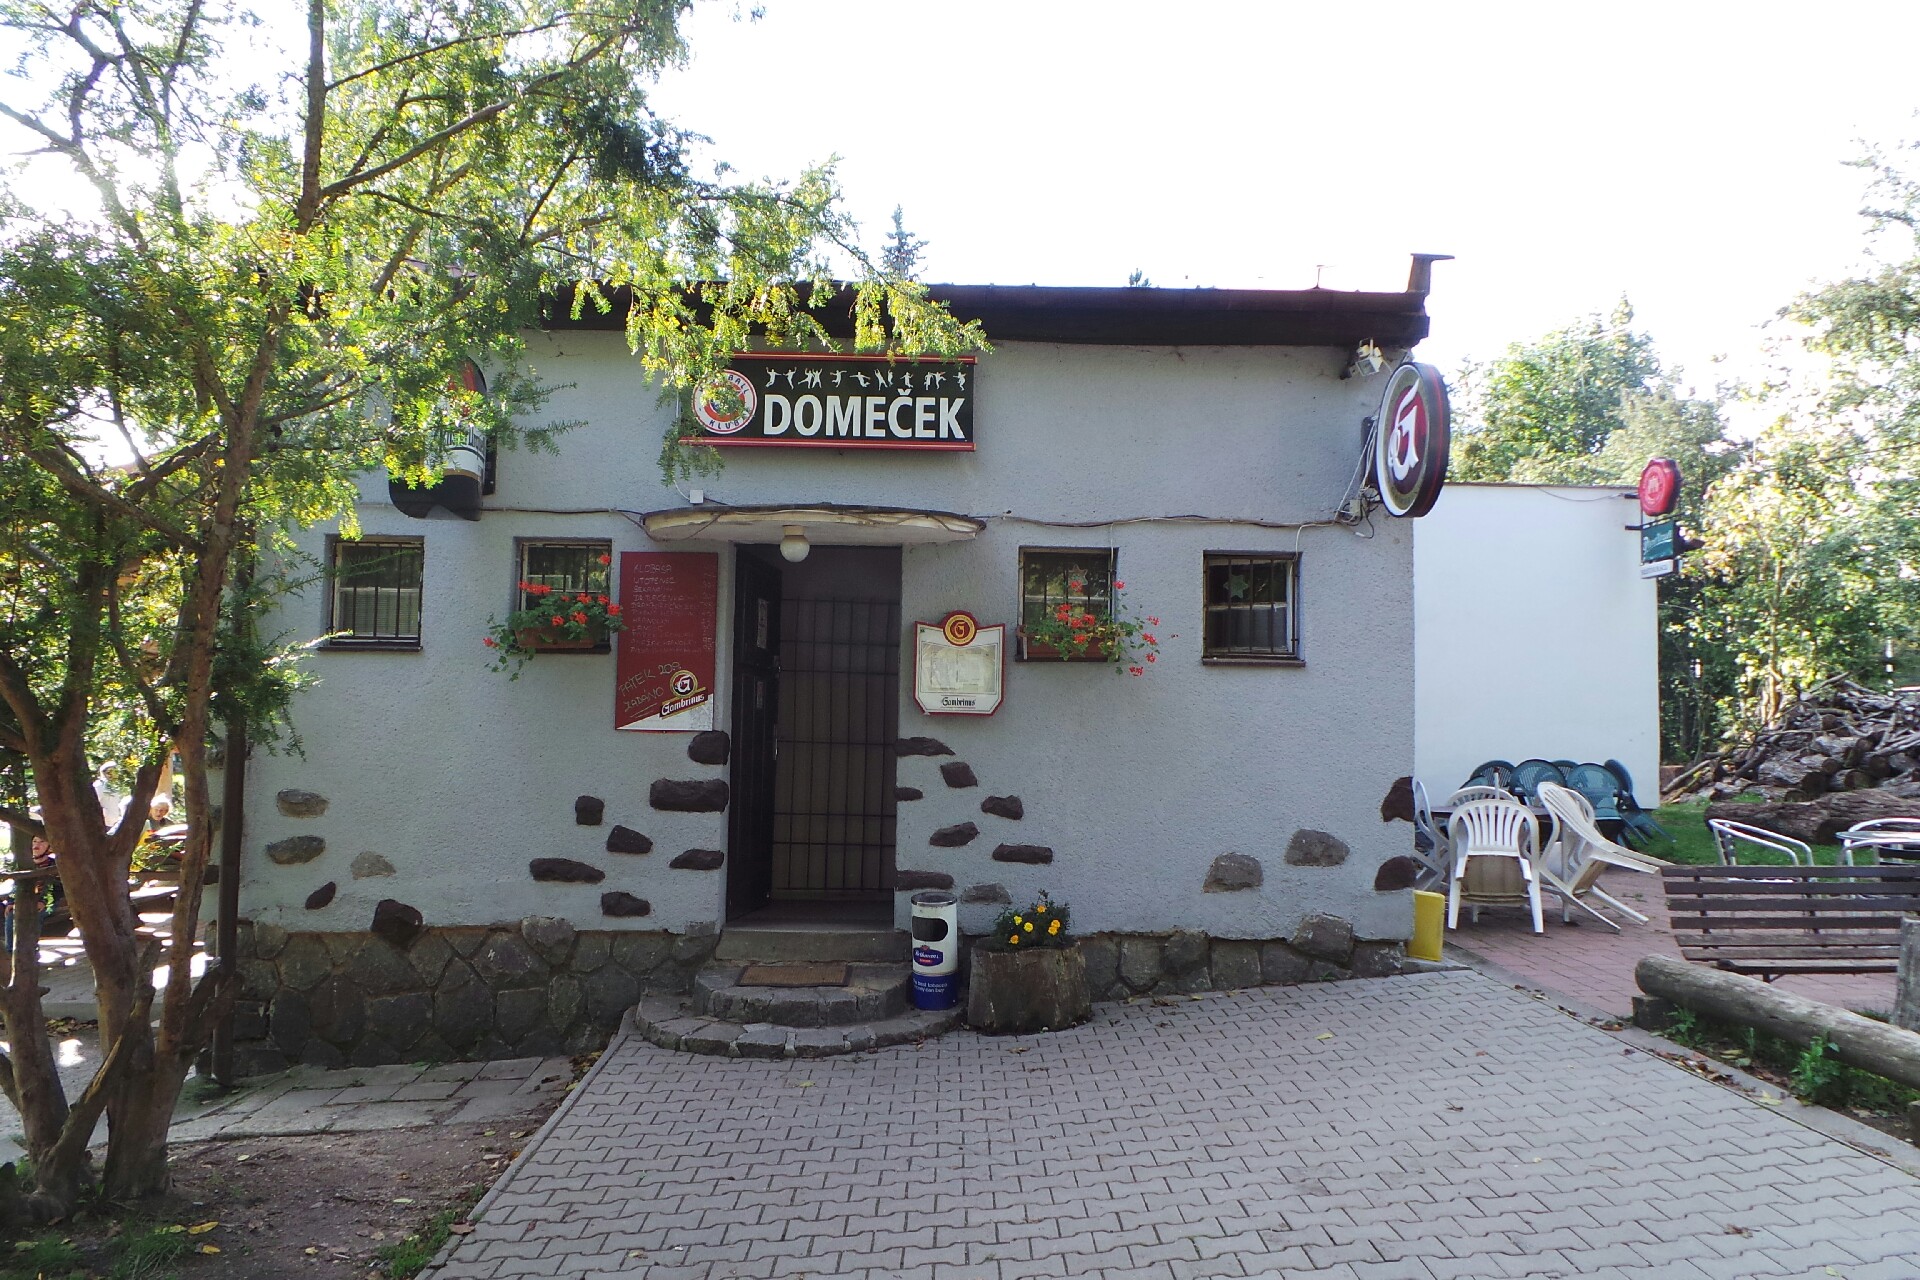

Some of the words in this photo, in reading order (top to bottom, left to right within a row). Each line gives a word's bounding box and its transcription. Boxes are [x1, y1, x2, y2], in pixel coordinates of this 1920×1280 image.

[763, 388, 965, 439] DOMEČEK
[708, 419, 740, 429] KLUB
[661, 693, 705, 716] Gambrinus
[942, 696, 976, 707] Gambrinus
